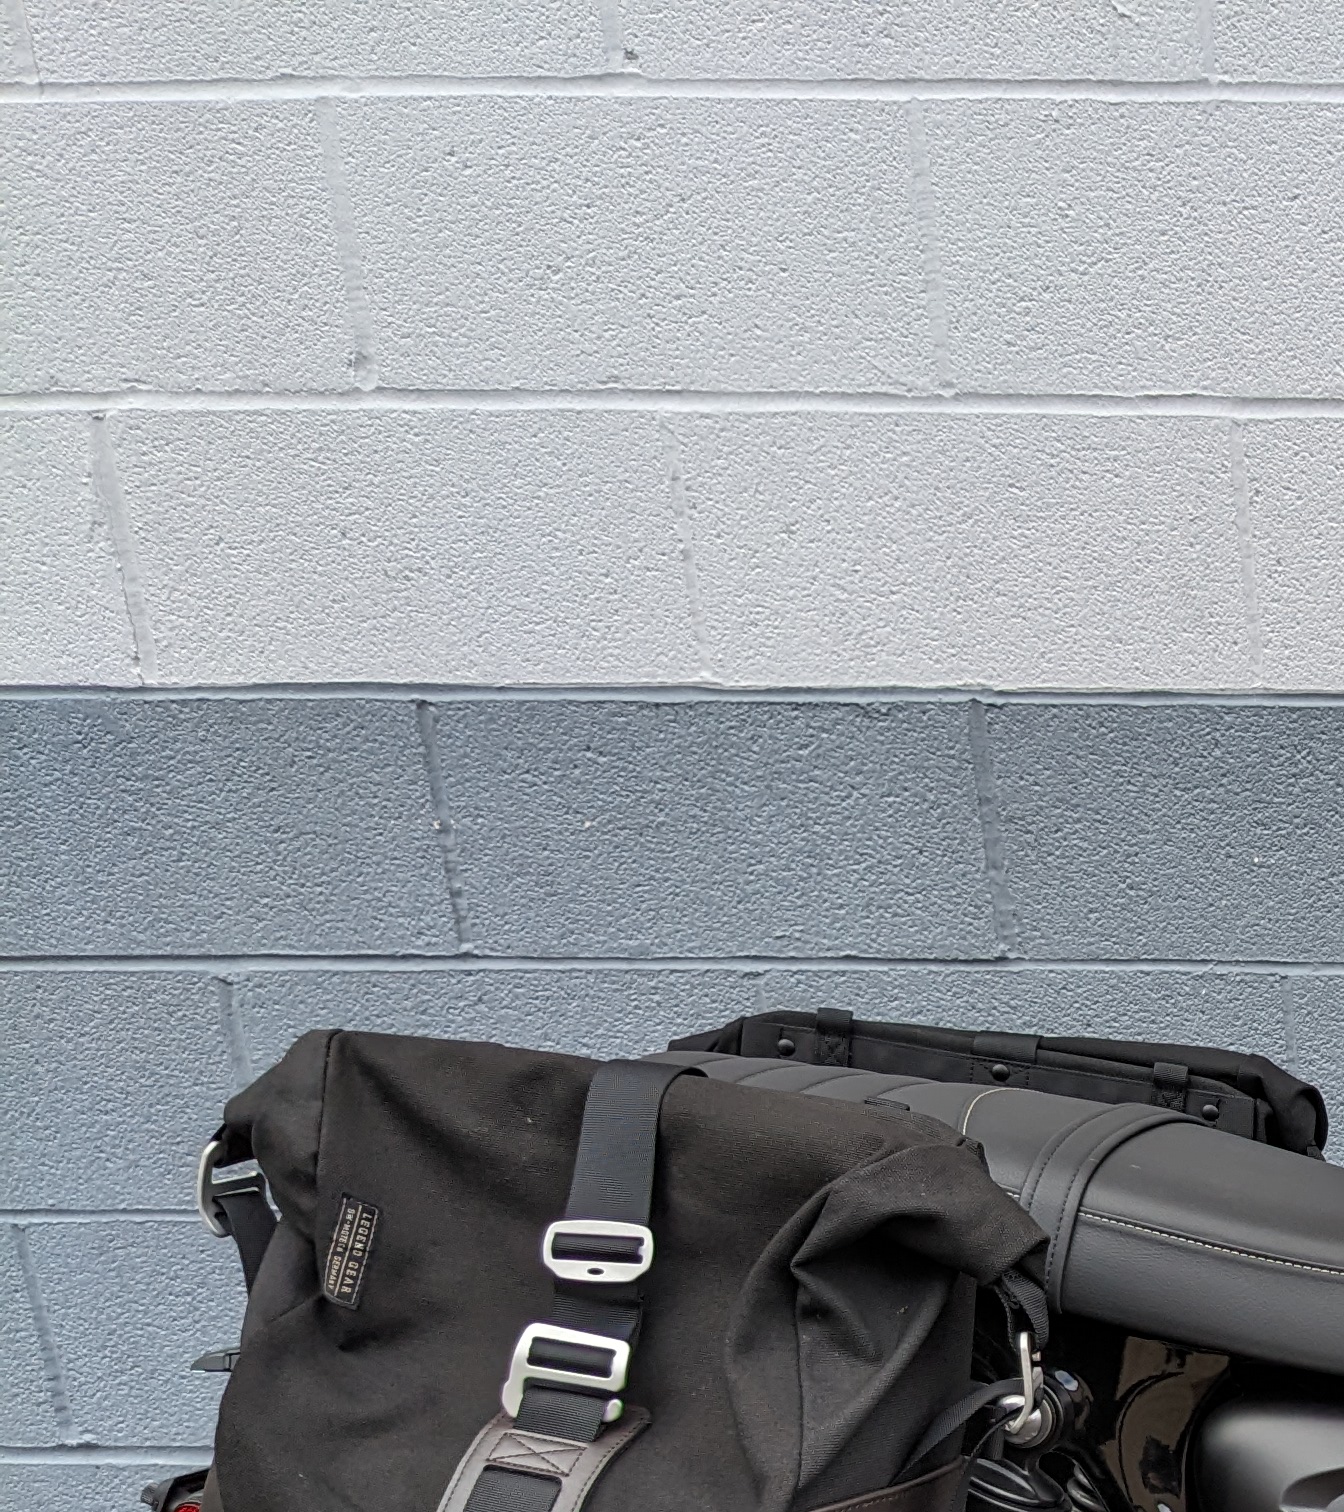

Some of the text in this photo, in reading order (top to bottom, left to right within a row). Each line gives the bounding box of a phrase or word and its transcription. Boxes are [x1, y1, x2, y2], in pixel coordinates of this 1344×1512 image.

[328, 1255, 342, 1290] GERMANY
[340, 1212, 373, 1294] LEGEND GEAR
